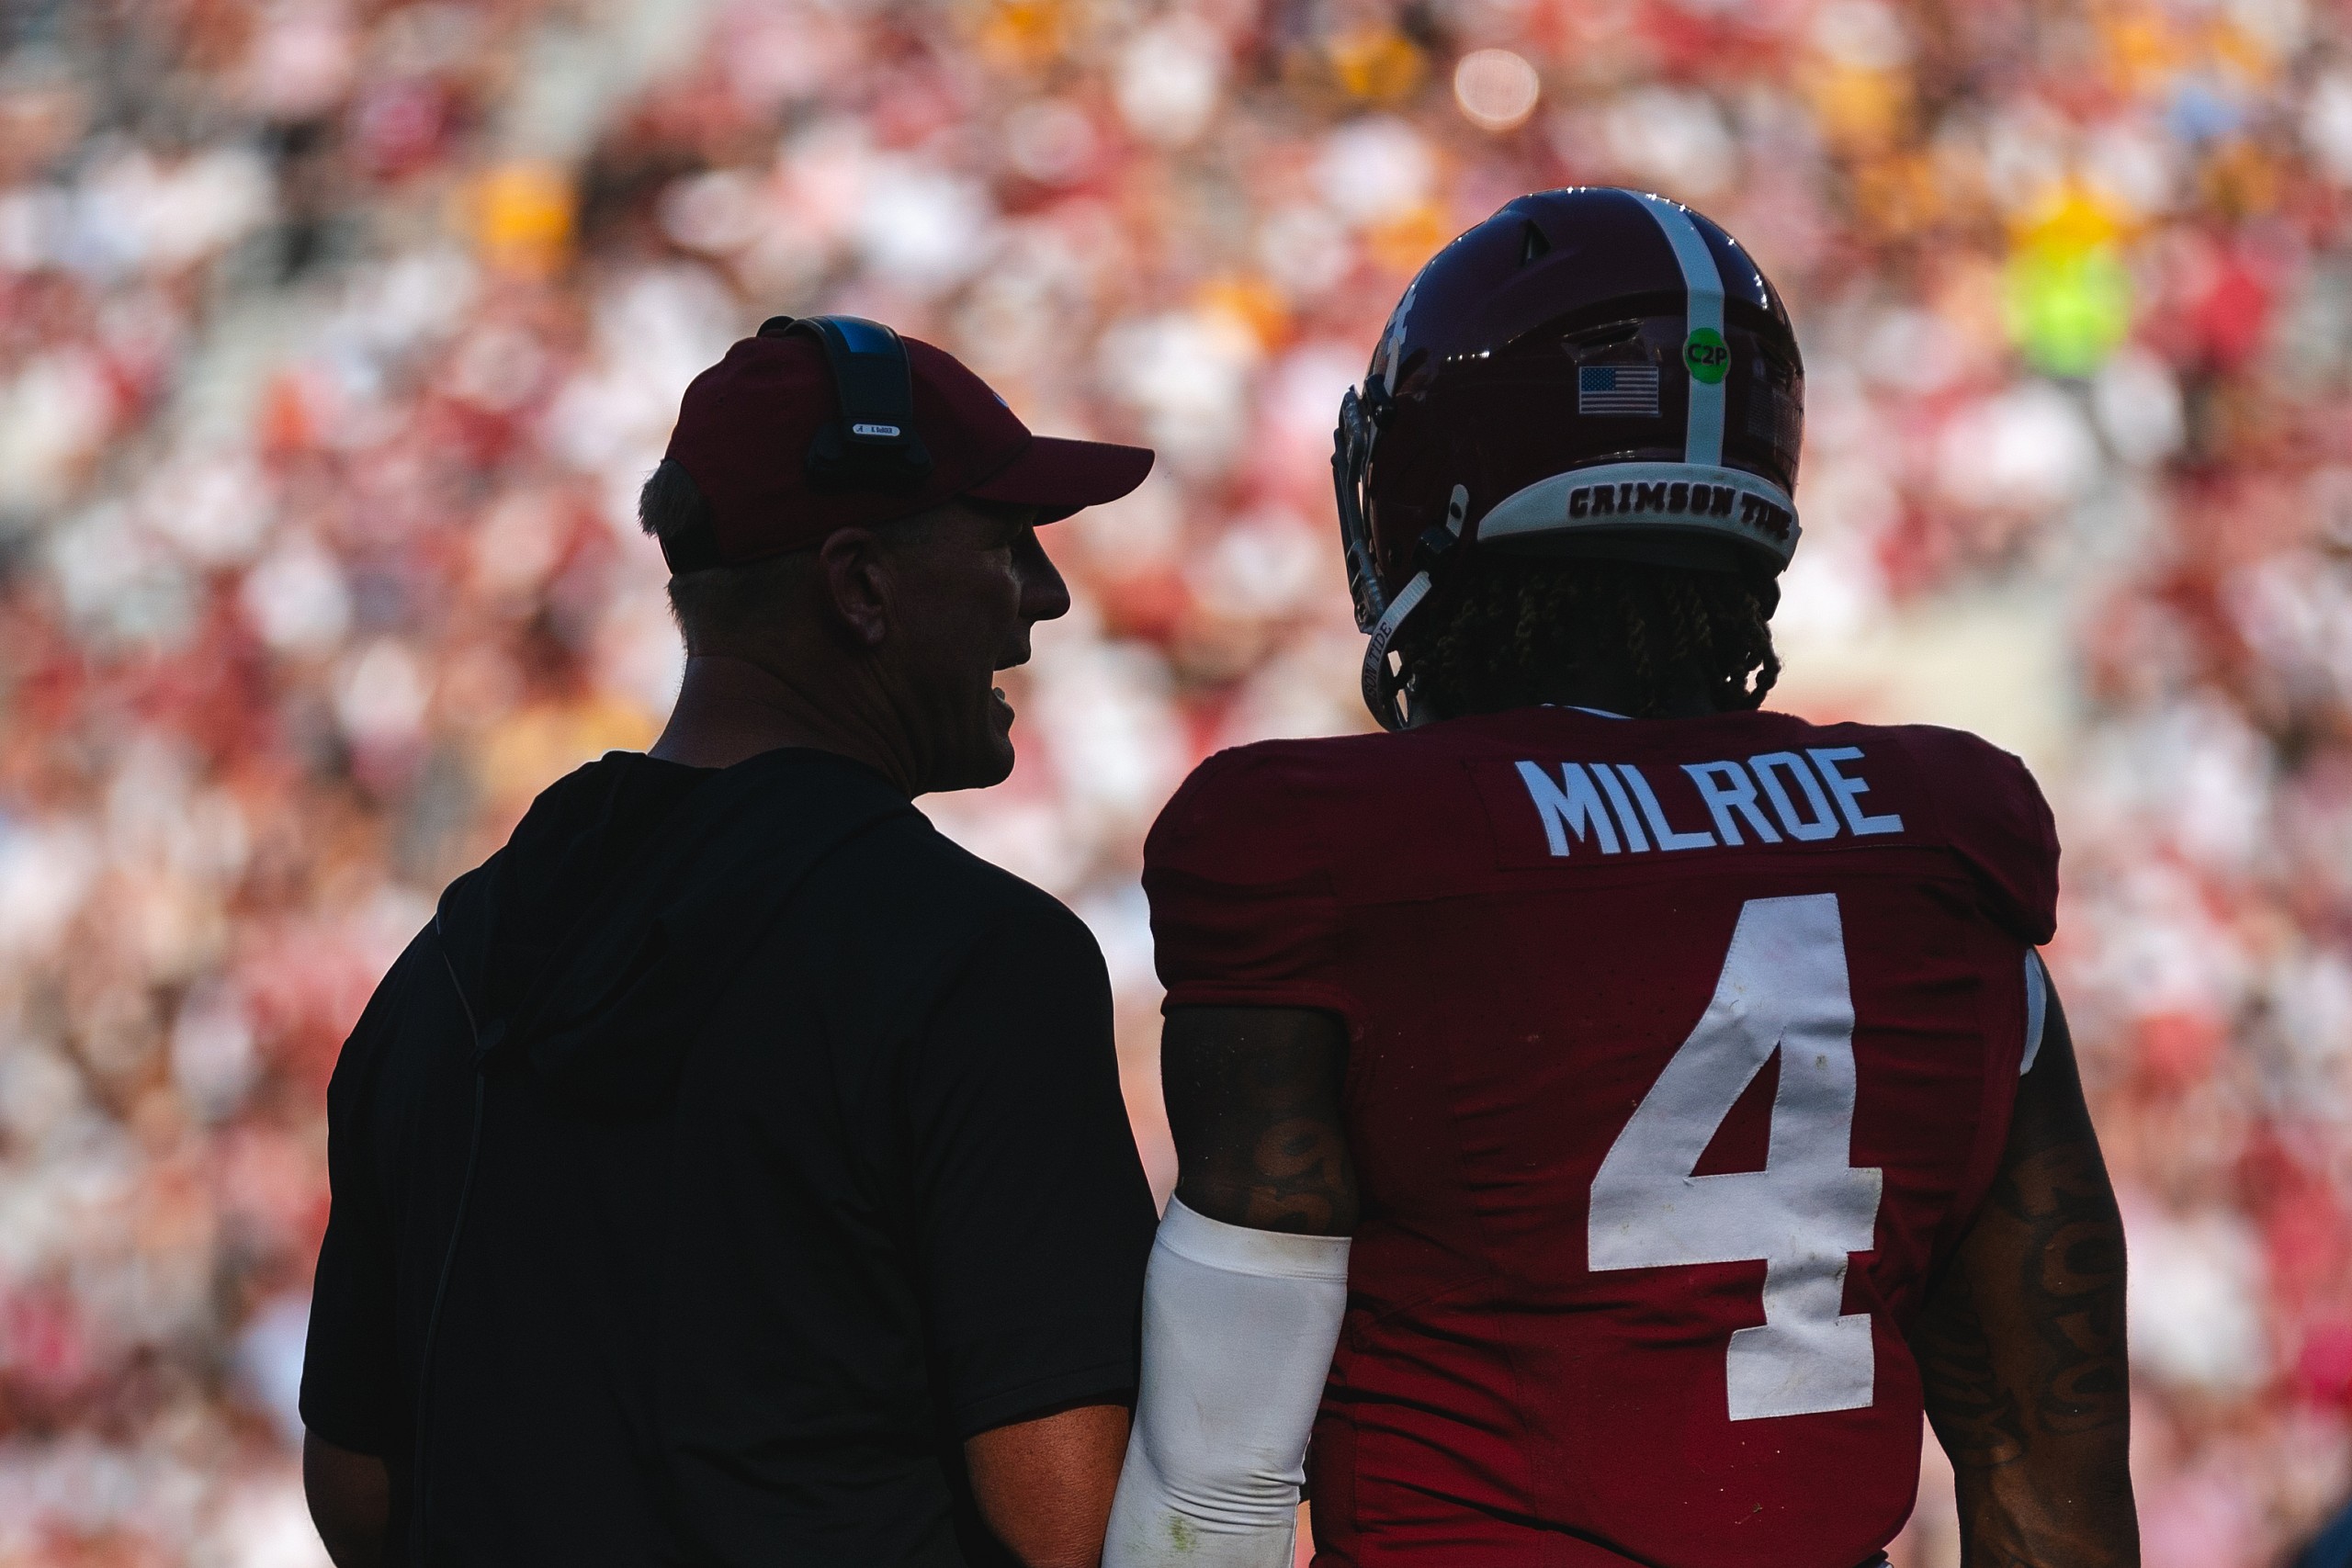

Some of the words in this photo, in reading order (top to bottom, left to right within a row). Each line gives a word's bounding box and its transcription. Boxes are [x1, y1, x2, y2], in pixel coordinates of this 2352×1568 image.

[1687, 343, 1728, 367] C2P
[1568, 480, 1737, 519] CRIMSON
[1740, 491, 1794, 541] TIDE
[1368, 621, 1393, 662] TIDE
[1514, 746, 1905, 857] MILROE
[1587, 892, 1883, 1422] 4
